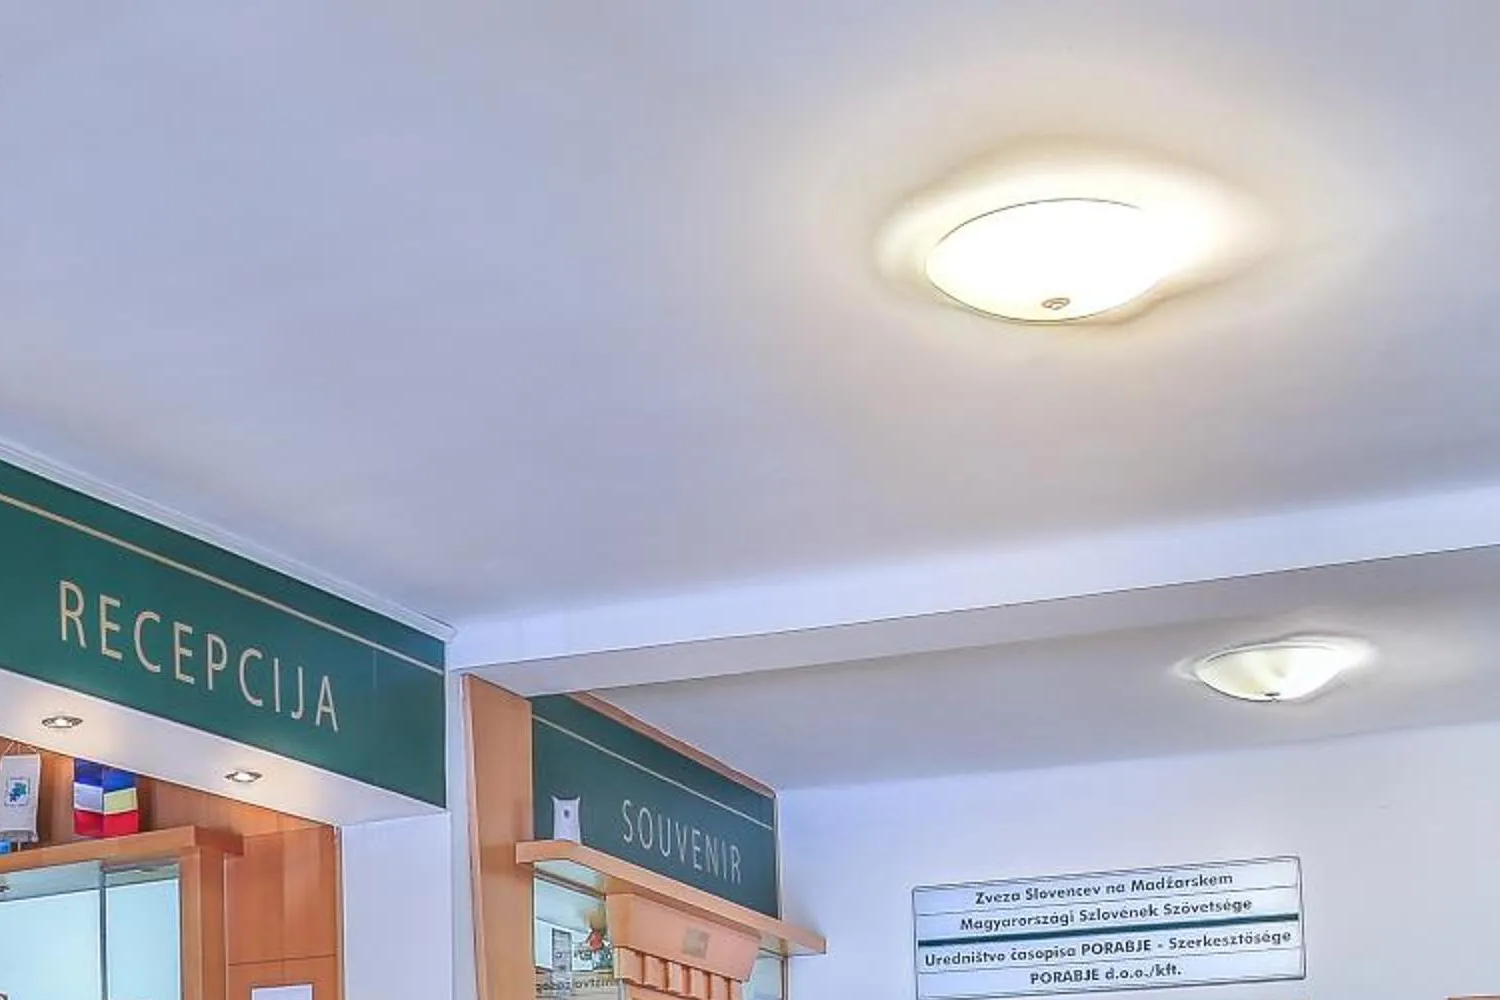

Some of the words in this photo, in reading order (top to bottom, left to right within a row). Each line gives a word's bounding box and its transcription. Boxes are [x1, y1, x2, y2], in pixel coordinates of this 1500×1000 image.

[58, 580, 340, 732] RECEPCIJA
[621, 799, 742, 884] SOUVENIR
[975, 892, 1021, 905] Zveza
[1025, 885, 1101, 901] Slovencev
[1106, 884, 1125, 894] na
[1131, 874, 1233, 892] Madžarskem
[959, 912, 1075, 932] Magyarországi
[1079, 903, 1159, 922] Szlovének
[1163, 899, 1252, 915] Szövetsége
[925, 950, 1005, 967] Uredništvo
[1011, 945, 1076, 962] časopisa
[1081, 939, 1152, 956] PORABJE
[1030, 968, 1099, 985] PORABJE
